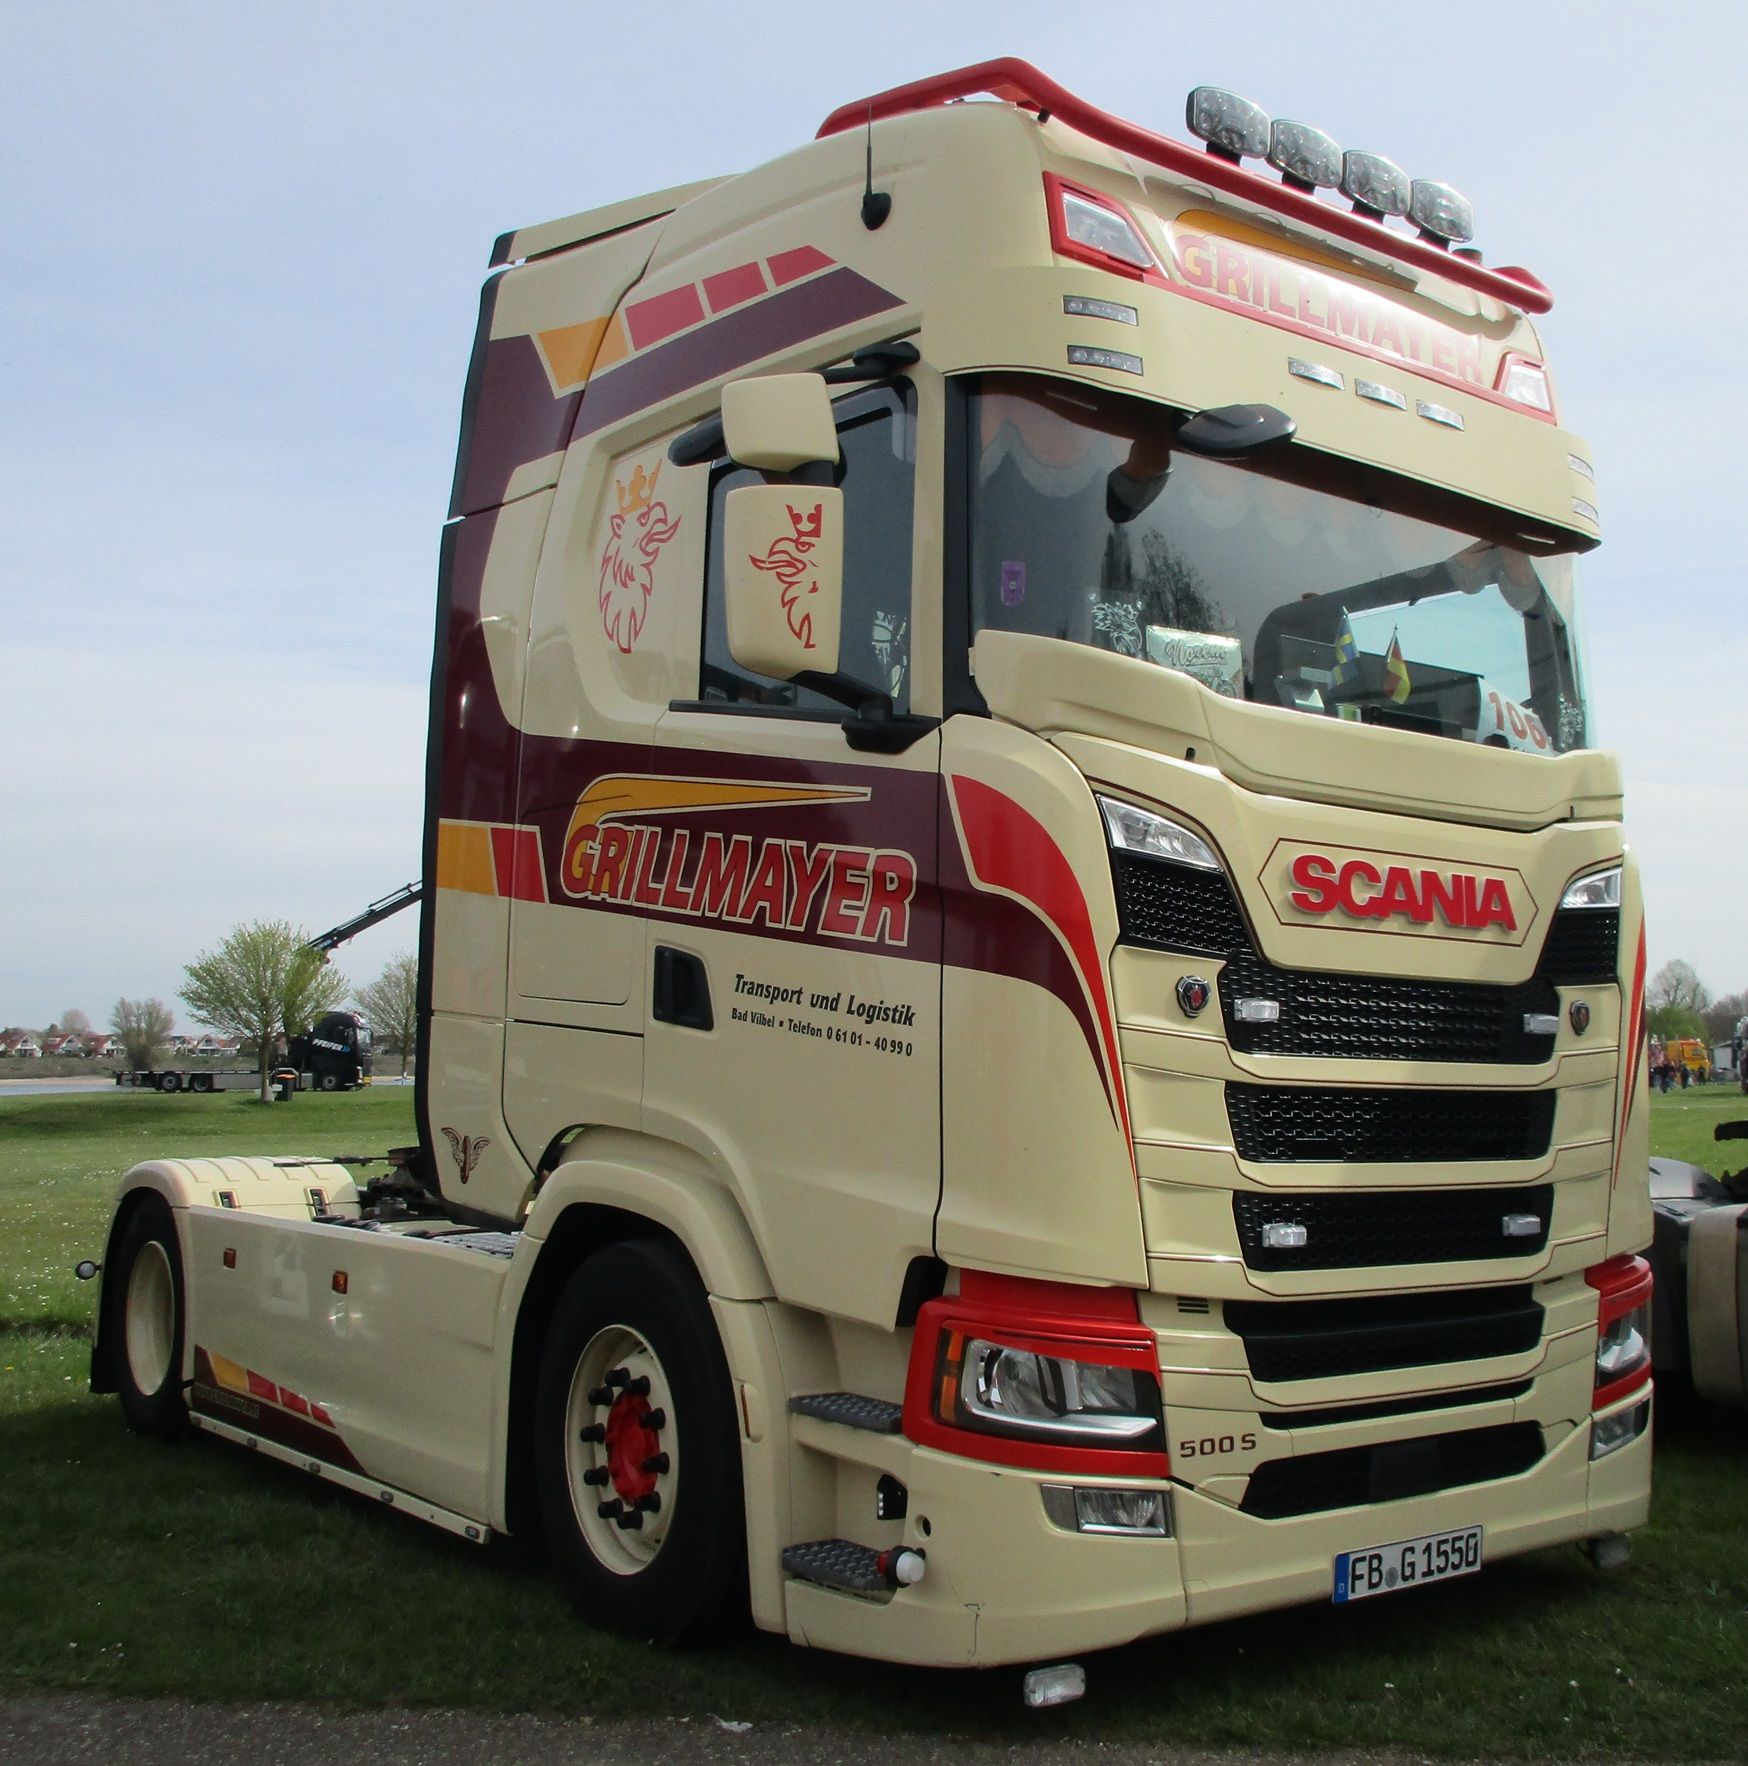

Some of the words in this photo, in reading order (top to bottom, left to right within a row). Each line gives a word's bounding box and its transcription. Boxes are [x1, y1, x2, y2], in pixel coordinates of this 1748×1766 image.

[1175, 233, 1486, 385] GRILLMAYER
[1488, 691, 1548, 750] 106
[561, 823, 917, 947] GRILLMAYER
[1289, 853, 1518, 932] SCANIA
[731, 1008, 748, 1023] Bad
[750, 1011, 775, 1028] Vilbel
[788, 1018, 822, 1038] Telefon
[826, 1026, 833, 1040] 0
[734, 974, 804, 1005] Transport
[809, 992, 842, 1012] und
[846, 994, 916, 1027] Logistik
[312, 1038, 343, 1051] PFEIFER
[1180, 1436, 1234, 1458] 500
[1241, 1433, 1256, 1451] S
[1350, 1553, 1383, 1594] FB
[1401, 1546, 1415, 1582] G
[1421, 1532, 1478, 1578] 1550
